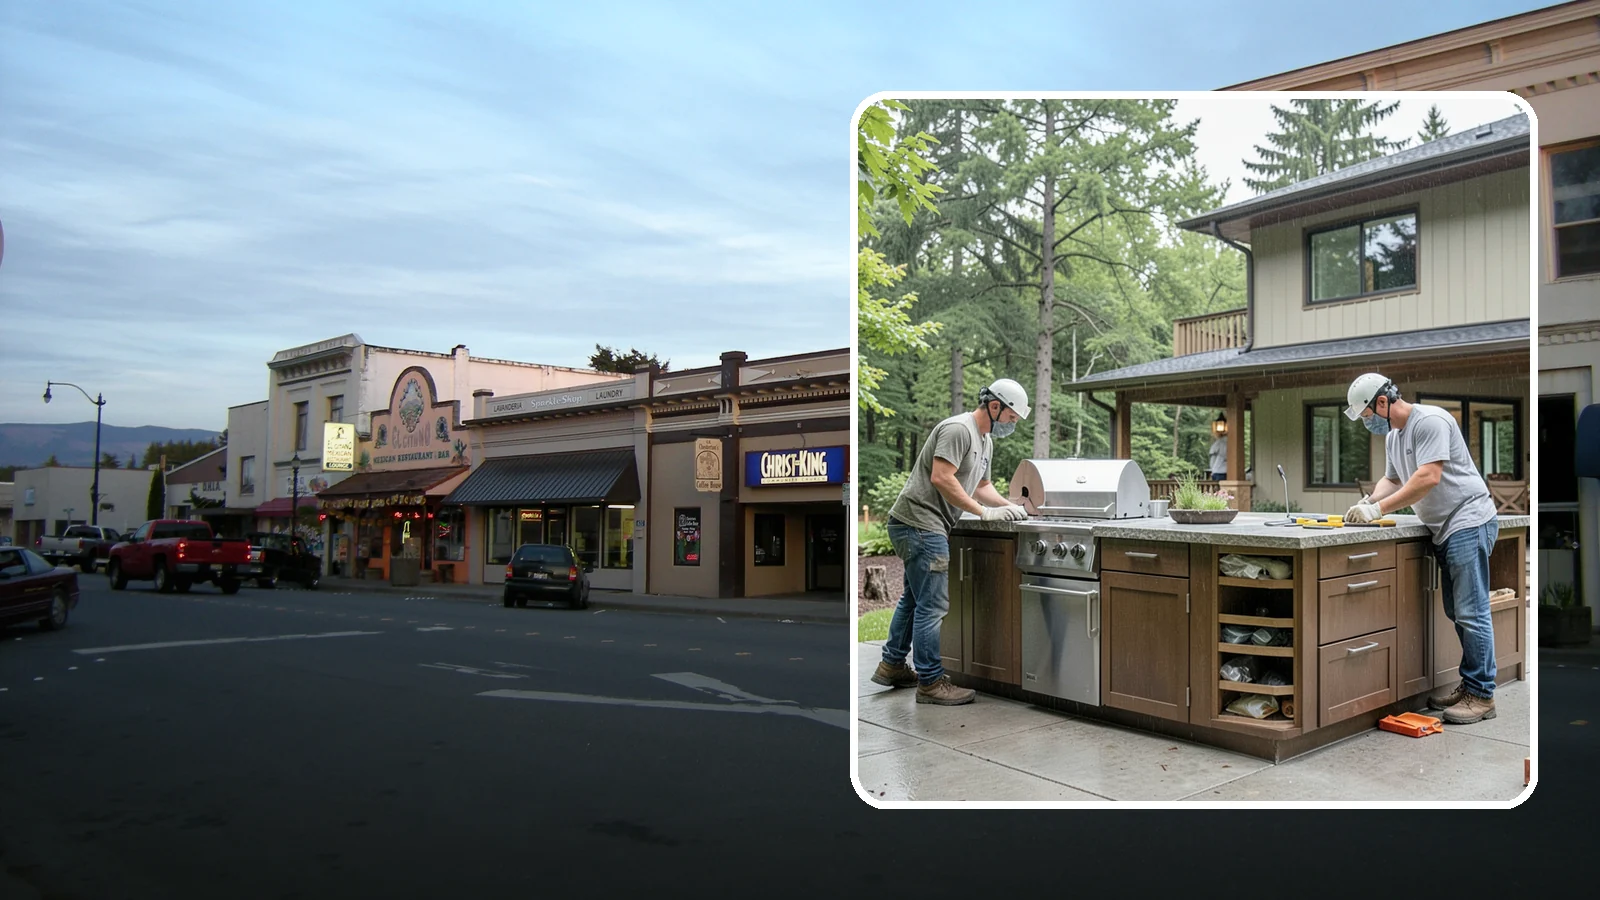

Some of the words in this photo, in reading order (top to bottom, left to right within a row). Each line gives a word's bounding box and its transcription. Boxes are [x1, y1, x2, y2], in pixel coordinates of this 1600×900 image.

[595, 389, 623, 400] LAUNDRY
[493, 402, 522, 412] LAVANDERIA
[373, 455, 396, 464] MEXICAN
[398, 452, 433, 462] RESTAURANT
[438, 450, 450, 459] BAR
[761, 452, 797, 478] CHRIST
[799, 450, 827, 476] KING
